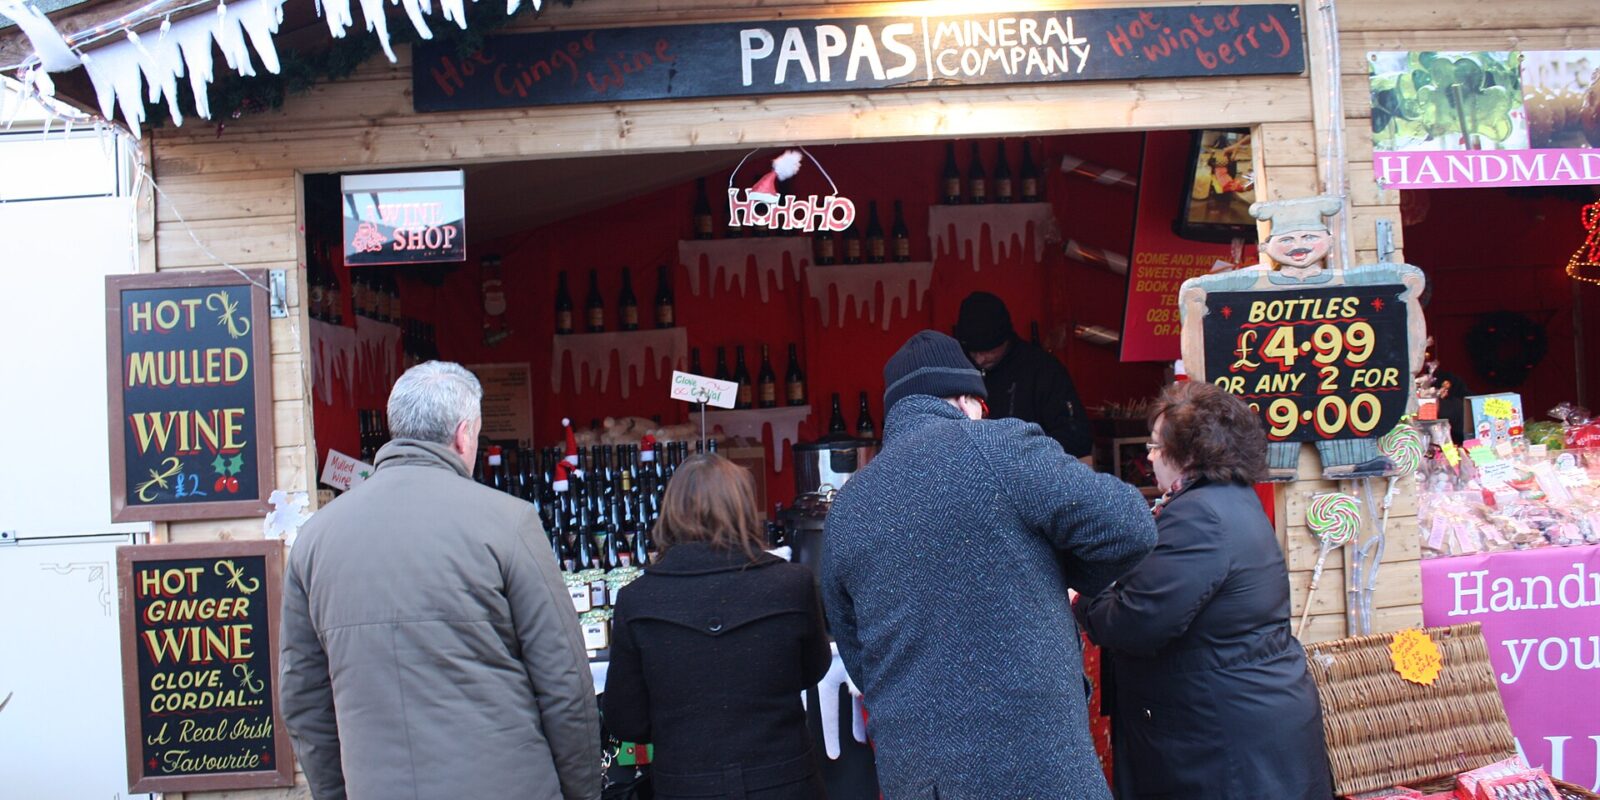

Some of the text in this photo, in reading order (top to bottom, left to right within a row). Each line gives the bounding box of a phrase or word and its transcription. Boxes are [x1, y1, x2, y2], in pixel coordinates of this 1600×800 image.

[933, 17, 1087, 49] MINERAL
[1107, 10, 1161, 57] Hot
[1196, 14, 1291, 70] berry
[494, 31, 598, 98] Ginger
[740, 23, 917, 87] PAPAS
[935, 44, 1091, 77] COMPANY
[1378, 152, 1600, 185] HANDMAD
[378, 202, 444, 226] WINE
[392, 225, 457, 251] SHOP
[1136, 252, 1170, 265] COME
[1171, 254, 1194, 265] AND
[1137, 266, 1183, 279] SWEETS
[1136, 280, 1169, 292] BOOK
[129, 299, 202, 333] HOT
[1146, 308, 1170, 322] 028
[1248, 296, 1360, 323] BOTTLES
[1153, 324, 1171, 336] OR
[126, 347, 248, 388] MULLED
[1214, 365, 1400, 395] OR ANY 2 FOR
[1248, 393, 1382, 440] 9.00
[129, 408, 247, 456] WINE
[175, 474, 208, 498] £2
[137, 569, 204, 598] HOT
[1448, 563, 1600, 616] Hand
[144, 597, 250, 625] GINGER
[142, 624, 255, 666] WINE
[150, 670, 223, 692] CLOVE,
[150, 690, 263, 713] CORDIAL...
[148, 717, 273, 745] A Real Irish
